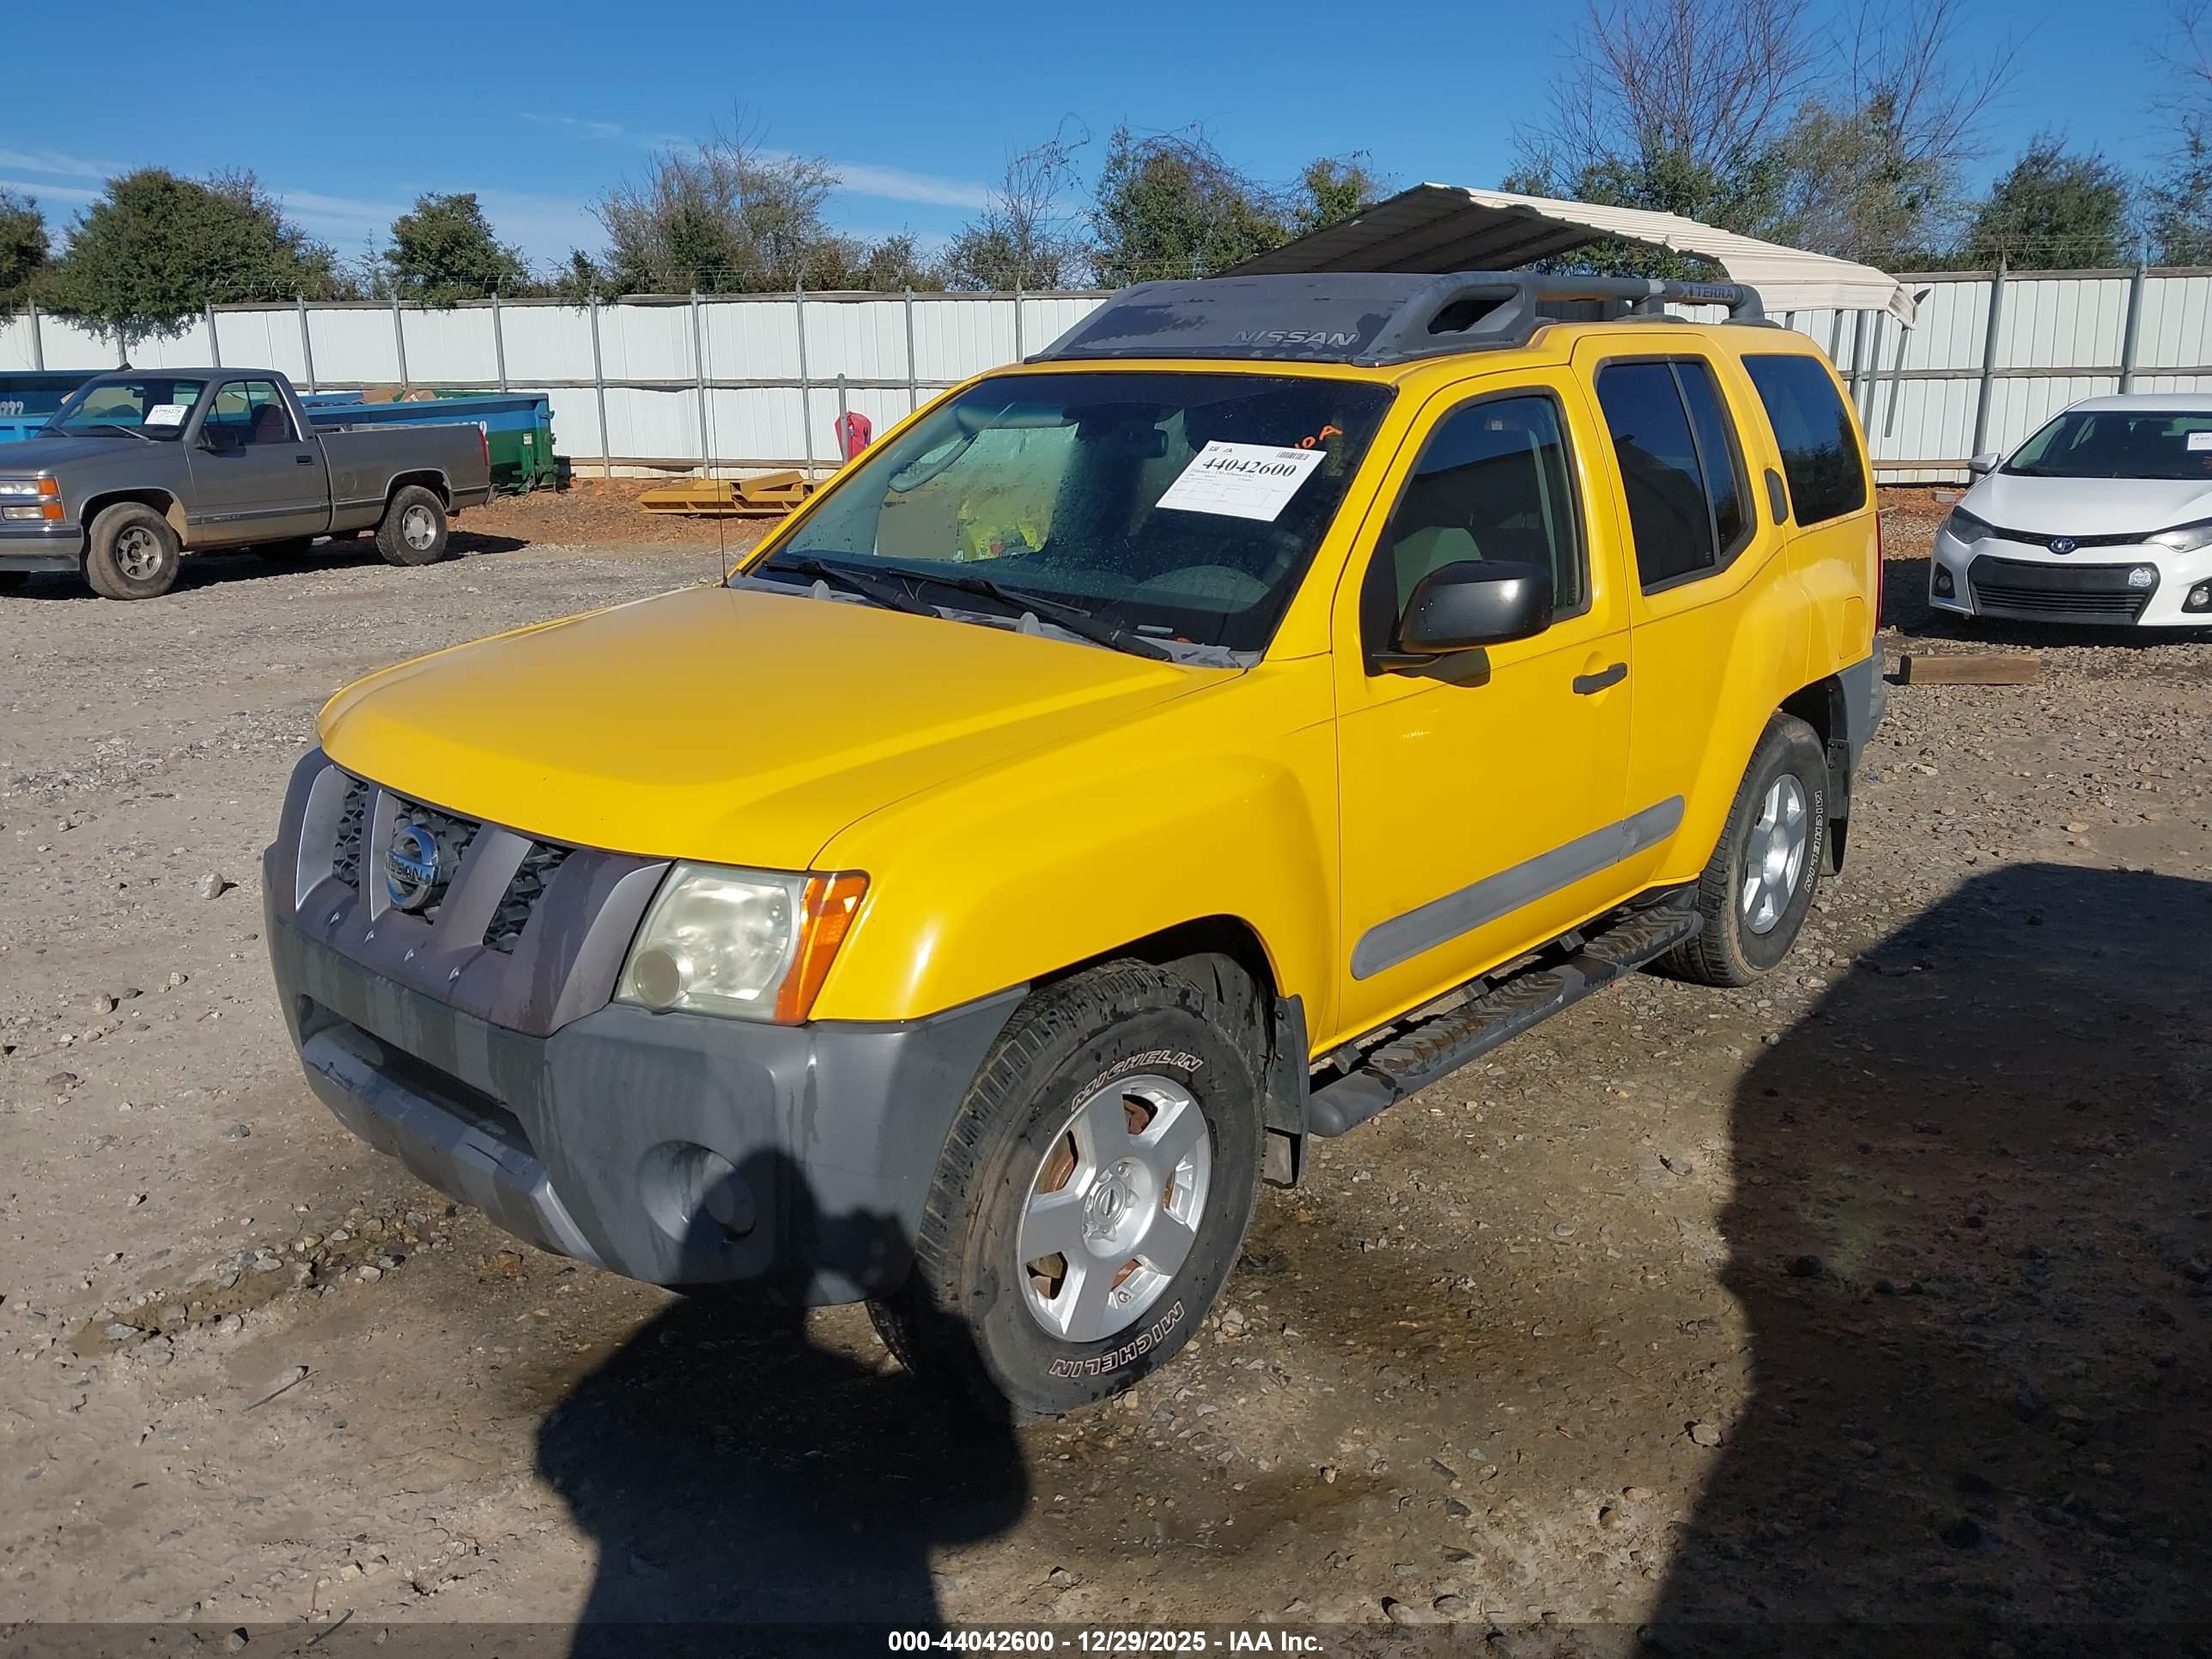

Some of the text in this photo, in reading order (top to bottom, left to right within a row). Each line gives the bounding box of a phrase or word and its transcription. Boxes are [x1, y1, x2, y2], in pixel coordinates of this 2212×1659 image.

[1230, 330, 1358, 346] NISSAN
[1202, 457, 1297, 477] 44042600
[1804, 789, 1824, 894] MICHELIN
[1071, 1049, 1204, 1113] MICHELIN
[1048, 1300, 1185, 1378] MICHELIN
